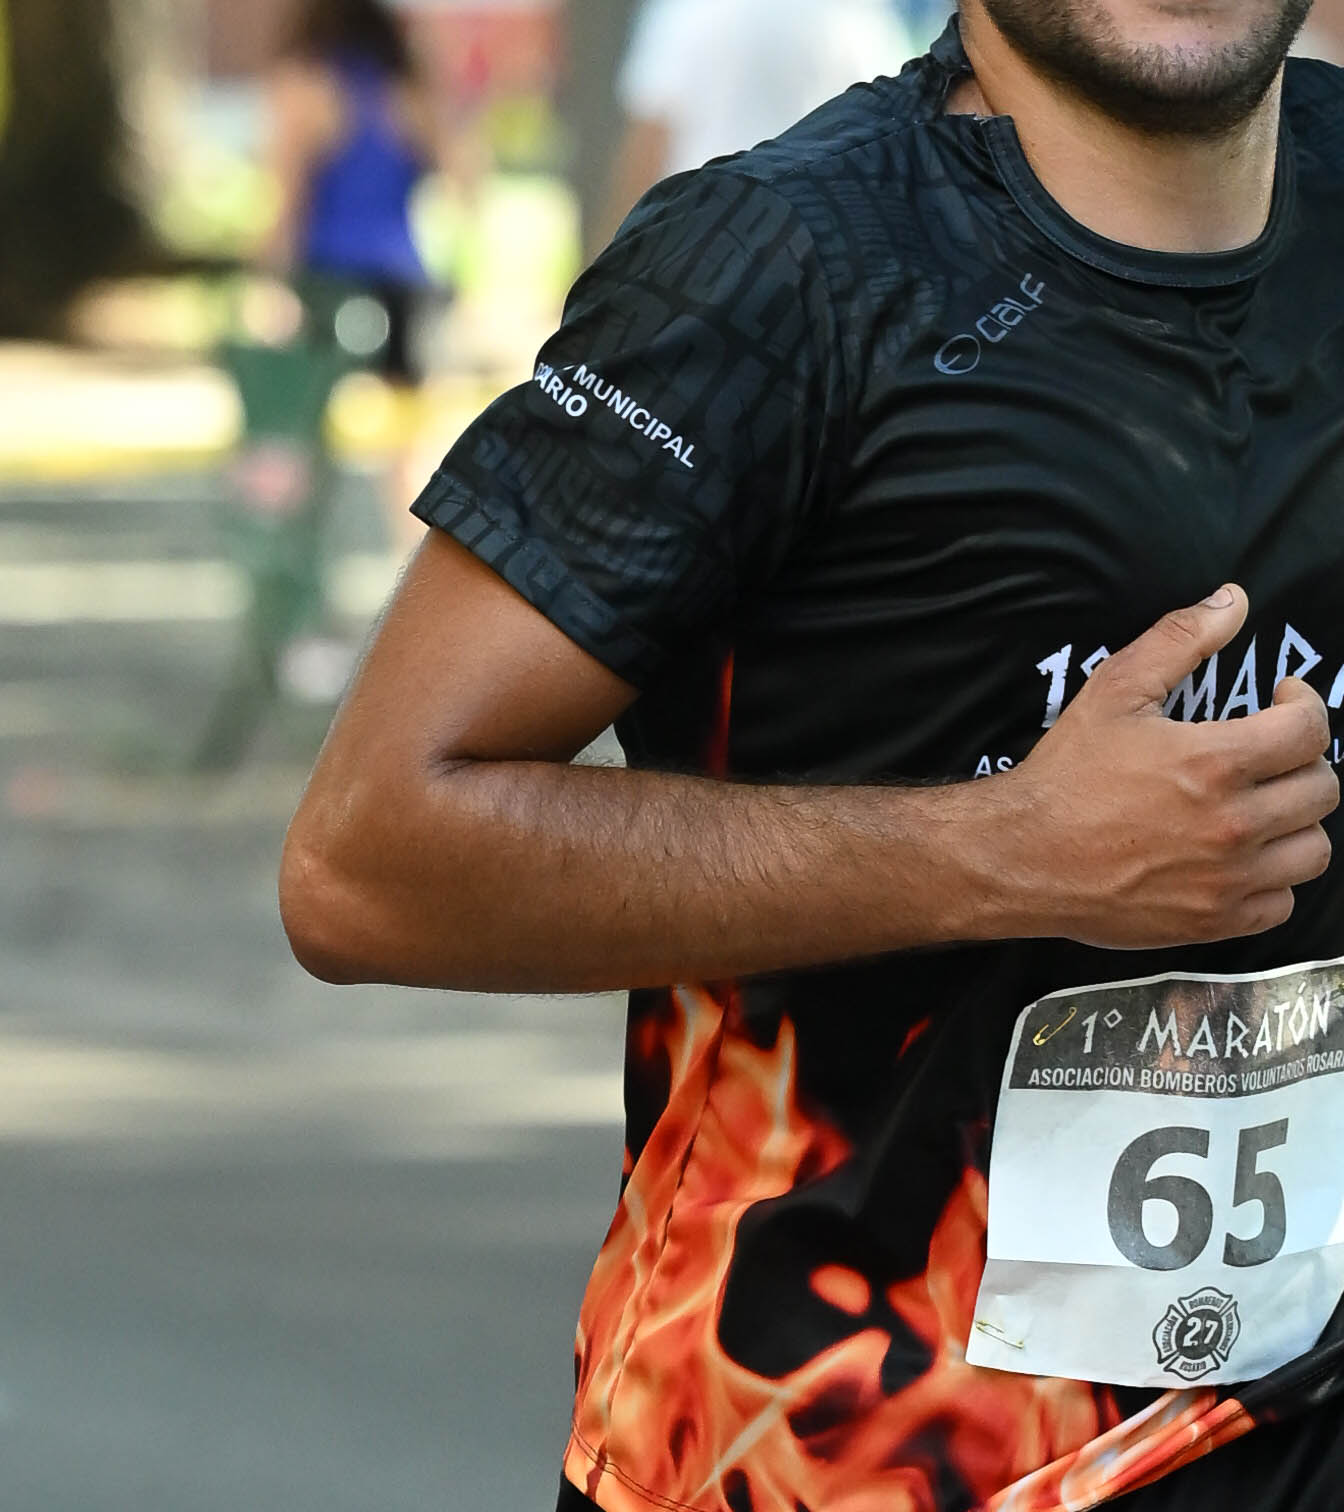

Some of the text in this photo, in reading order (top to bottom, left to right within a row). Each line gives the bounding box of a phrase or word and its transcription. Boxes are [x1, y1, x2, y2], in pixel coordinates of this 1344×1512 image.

[534, 362, 587, 417] ARIO
[573, 364, 695, 469] MUNICIPAL
[1081, 981, 1332, 1060] 1° MARATÓN
[1027, 1063, 1135, 1088] ASOCIACIÓN
[1139, 1068, 1237, 1094] BOMBEROS
[1240, 1056, 1306, 1092] VOLUNTARIOS
[1106, 1117, 1290, 1272] 65
[1182, 1316, 1219, 1347] 27
